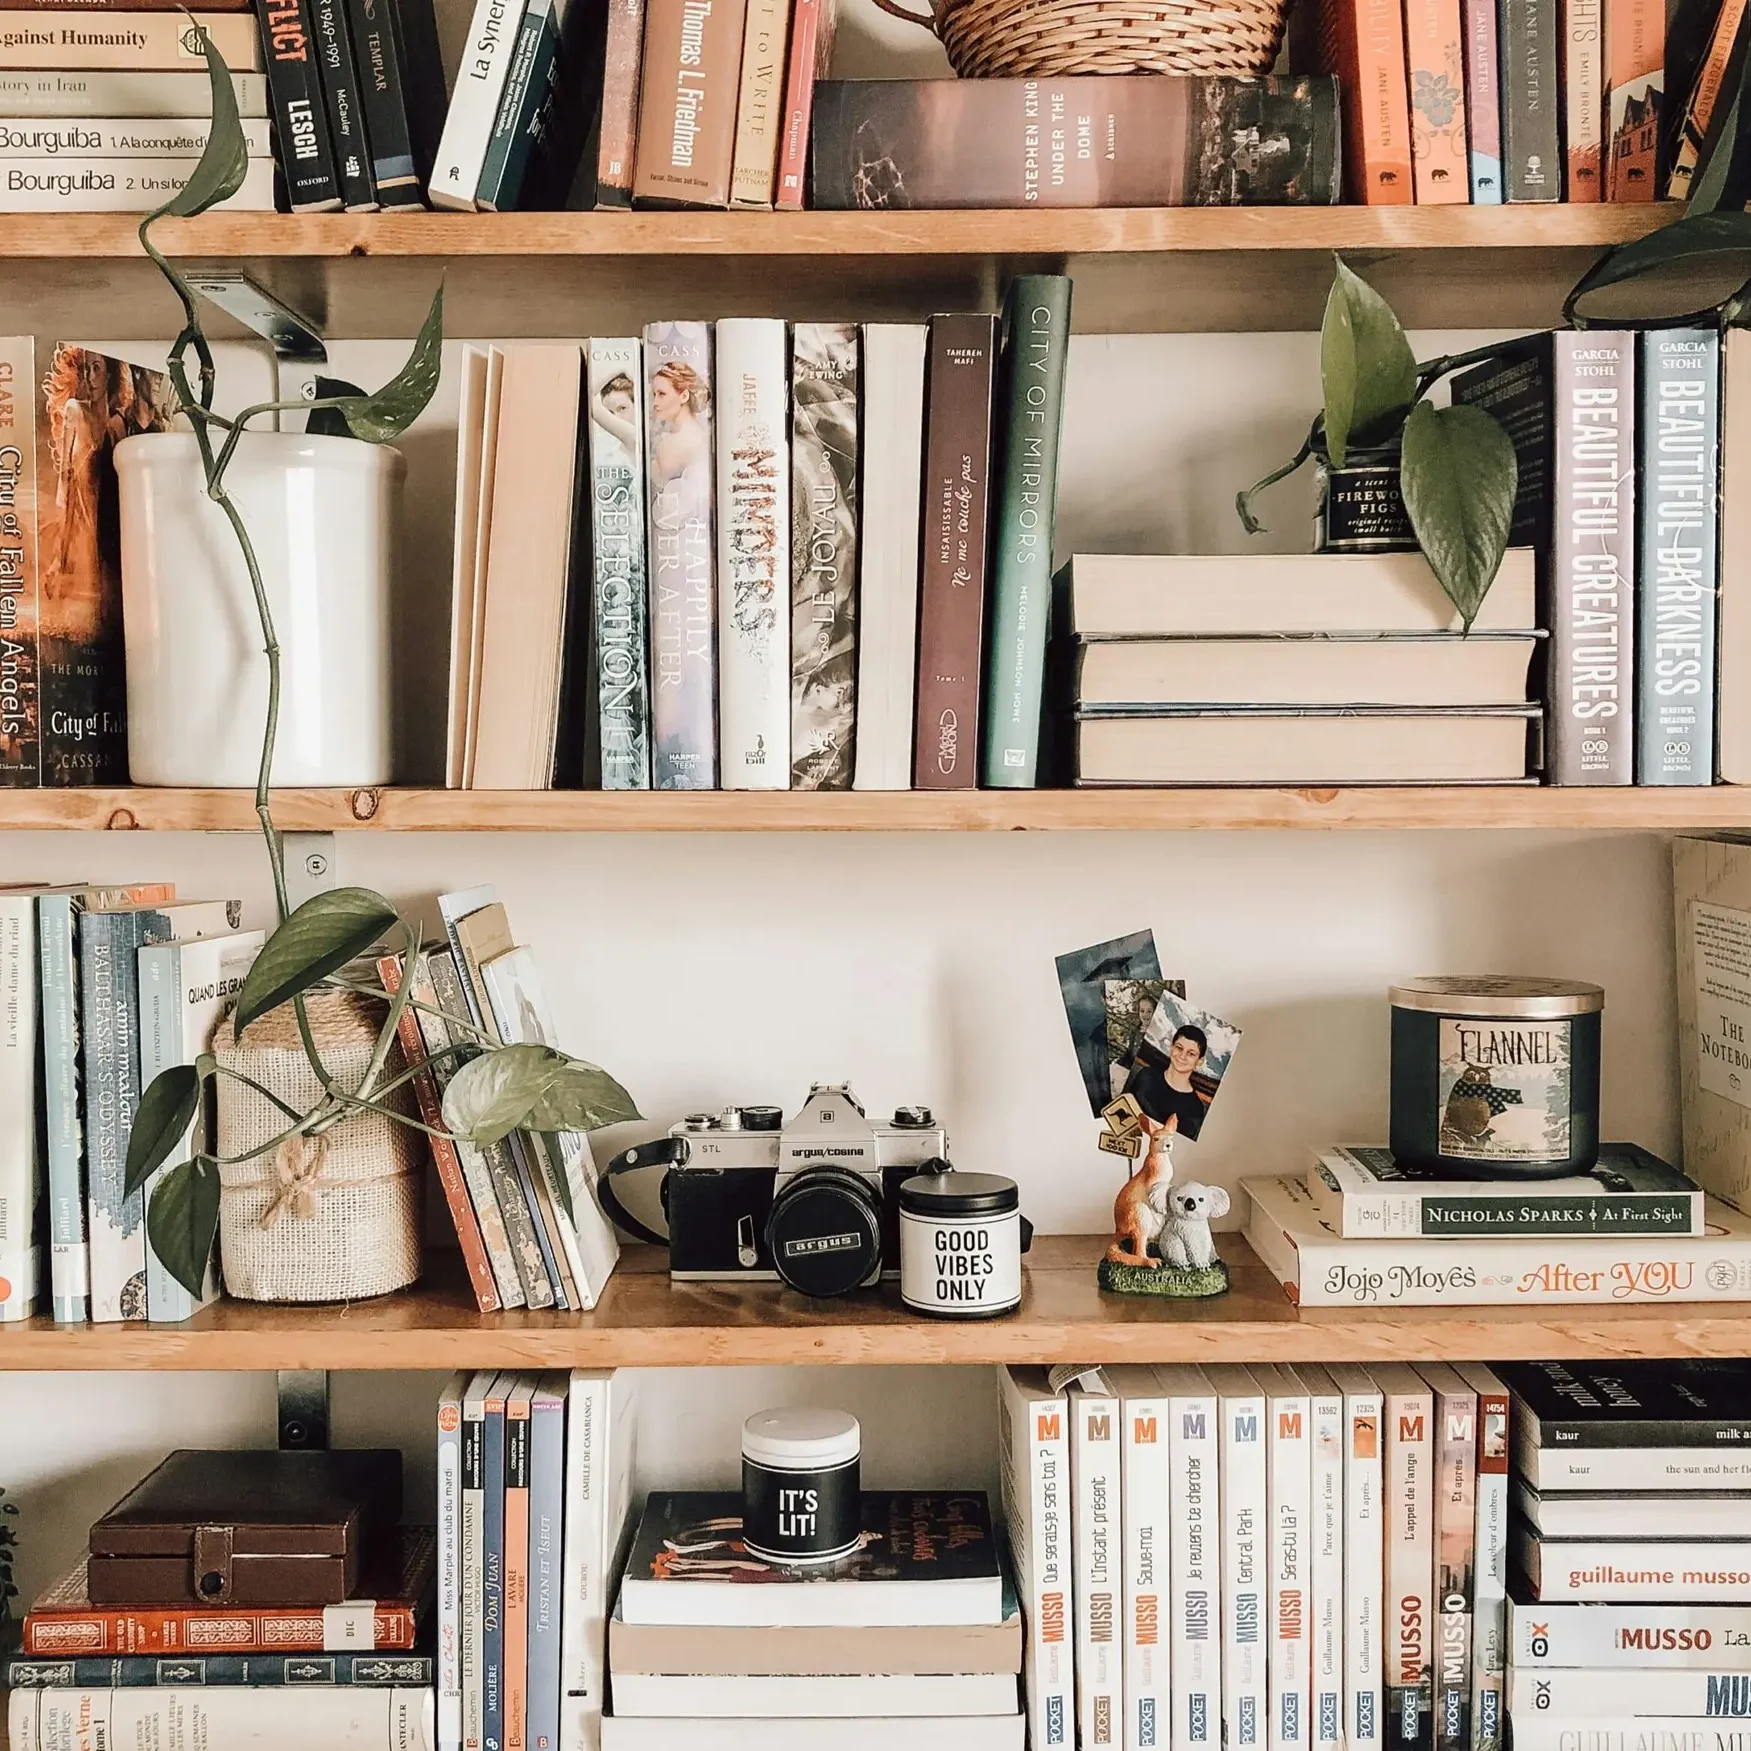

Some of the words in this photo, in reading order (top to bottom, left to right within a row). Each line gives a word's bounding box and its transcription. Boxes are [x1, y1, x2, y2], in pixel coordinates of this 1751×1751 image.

[61, 29, 148, 49] Humanity
[678, 0, 712, 66] Thomas
[1475, 10, 1488, 41] JANE
[368, 32, 388, 91] TEMPLAR
[1477, 45, 1489, 93] AUSTEN
[1526, 47, 1538, 111] AUSTEN
[1579, 53, 1589, 86] EMILY
[57, 78, 88, 92] Iran
[1377, 66, 1389, 96] JANE
[336, 89, 352, 136] McCauley
[751, 64, 773, 137] WRITE
[1026, 81, 1038, 118] KING
[1052, 92, 1064, 122] THE
[287, 100, 319, 160] LESCH
[671, 89, 705, 168] Friedman
[788, 109, 802, 160] Chapman
[1077, 115, 1090, 159] DOME
[1379, 98, 1391, 147] AUSTEN
[1025, 124, 1039, 201] STEPHEN
[1051, 126, 1064, 186] UNDER
[8, 171, 115, 195] Bourguiba
[297, 176, 329, 187] OXFORD
[658, 345, 700, 357] CASS
[946, 349, 982, 357] TAHEREH
[1031, 305, 1052, 370] CITY
[1571, 349, 1619, 360] GARCIA
[1658, 341, 1708, 353] GARCIA
[592, 350, 630, 362] CASS
[815, 360, 838, 369] AMY
[1575, 366, 1616, 377] STOHL
[1662, 358, 1704, 369] STOHL
[809, 370, 843, 379] EWING
[741, 373, 756, 414] JAFFE
[1026, 389, 1047, 425] OF
[0, 446, 23, 505] City
[598, 467, 632, 481] THE
[1572, 388, 1619, 544] BEAUTIFUL
[1656, 380, 1706, 537] BEAUTIFUL
[953, 480, 972, 539] touche
[1016, 434, 1045, 566] MIRRORS
[1360, 503, 1397, 514] FIGS
[3, 513, 22, 540] of
[812, 485, 837, 580] JOYAU
[941, 477, 954, 564] INSAISISSABLE
[1347, 517, 1381, 527] original
[956, 541, 968, 564] me
[1, 545, 24, 629] Fallen
[686, 518, 708, 664] HAPPILY
[951, 565, 967, 588] Ne
[596, 485, 635, 713] SELECTION
[812, 593, 835, 624] LE
[1017, 585, 1029, 634] MELODIE
[660, 583, 683, 690] AFTER
[1572, 554, 1619, 720] CREATURES
[1654, 546, 1703, 696] DARKNESS
[51, 664, 71, 676] THE
[1014, 642, 1025, 688] JOHNSON
[0, 638, 24, 734] Angels
[51, 710, 82, 741] City
[8, 917, 20, 941] riad
[7, 962, 19, 993] dame
[188, 982, 215, 1004] QUAND
[94, 945, 114, 1083] BALTHASAR'S
[116, 1000, 132, 1048] amin
[1455, 1023, 1558, 1065] FLANNEL
[1701, 1032, 1751, 1070] NOTEBO
[118, 1052, 135, 1132] maalouf
[99, 1089, 117, 1187] ODYSSEY
[702, 1145, 721, 1153] STL
[447, 1160, 462, 1194] Nathan
[556, 1195, 566, 1220] MICHEL
[1427, 1206, 1514, 1223] NICHOLAS
[1518, 1205, 1584, 1222] SPARKS
[1602, 1208, 1618, 1221] At
[1621, 1207, 1648, 1221] First
[1651, 1207, 1684, 1224] Sight
[795, 1235, 852, 1251] argus
[935, 1230, 989, 1252] GOOD
[935, 1254, 994, 1276] VIBES
[1134, 1271, 1193, 1286] AUSTRALIA
[1324, 1264, 1383, 1302] Jojo
[1387, 1265, 1477, 1298] Moyes
[1517, 1263, 1604, 1293] After
[1610, 1262, 1696, 1298] YOU
[936, 1279, 986, 1300] ONLY
[583, 1396, 593, 1454] CASABIANCA
[1486, 1404, 1505, 1413] 14754
[1555, 1430, 1580, 1441] kaur
[1716, 1428, 1740, 1439] milk
[582, 1456, 591, 1468] DE
[1186, 1455, 1202, 1504] chercher
[1404, 1452, 1418, 1482] l'ange
[1569, 1464, 1591, 1474] kaur
[1666, 1465, 1682, 1474] the
[1684, 1466, 1700, 1474] sun
[1702, 1464, 1720, 1474] and
[1723, 1464, 1738, 1474] her
[582, 1469, 591, 1500] CAMILLE
[779, 1489, 819, 1513] IT'S
[1044, 1478, 1058, 1503] sans
[1091, 1476, 1107, 1524] présent
[1405, 1484, 1416, 1498] de
[444, 1514, 453, 1535] club
[778, 1513, 816, 1537] LIT!
[1041, 1506, 1058, 1556] serais-je
[1237, 1507, 1253, 1537] Park
[1324, 1511, 1334, 1528] que
[1360, 1508, 1369, 1519] Et
[1404, 1501, 1418, 1541] L'appel
[539, 1515, 552, 1553] ISEUT
[1186, 1523, 1202, 1564] reviens
[1322, 1530, 1333, 1556] Parce
[444, 1552, 455, 1587] Marple
[484, 1552, 501, 1592] JUAN
[539, 1557, 550, 1576] ET
[1042, 1558, 1058, 1583] Que
[1090, 1526, 1107, 1584] L'Instant
[1136, 1525, 1153, 1585] Sauve-moi
[1237, 1539, 1253, 1584] Central
[1281, 1532, 1297, 1580] Seras-tu
[464, 1564, 473, 1589] D'UN
[507, 1568, 517, 1609] L'AVARE
[580, 1563, 588, 1601] GOUROU
[1569, 1567, 1674, 1588] guillaume
[1682, 1571, 1751, 1584] musso
[444, 1589, 453, 1611] Miss
[464, 1590, 474, 1618] JOUR
[485, 1596, 499, 1632] DOM
[536, 1578, 550, 1633] TRISTAN
[1041, 1591, 1064, 1643] MUSSO
[1090, 1592, 1113, 1644] MUSSO
[138, 1625, 146, 1644] SHOP
[346, 1620, 355, 1637] DIC
[1135, 1594, 1158, 1645] MUSSO
[463, 1620, 473, 1664] DERNIER
[1621, 1628, 1712, 1651] MUSSO
[487, 1664, 498, 1712] MOLIÈRE
[75, 1694, 91, 1733] Verne
[466, 1690, 478, 1748] Beauchemin
[509, 1688, 521, 1747] Beauchemin
[1047, 1695, 1063, 1745] POCKET
[1094, 1696, 1110, 1745] POCKET
[1139, 1698, 1155, 1746] POCKET
